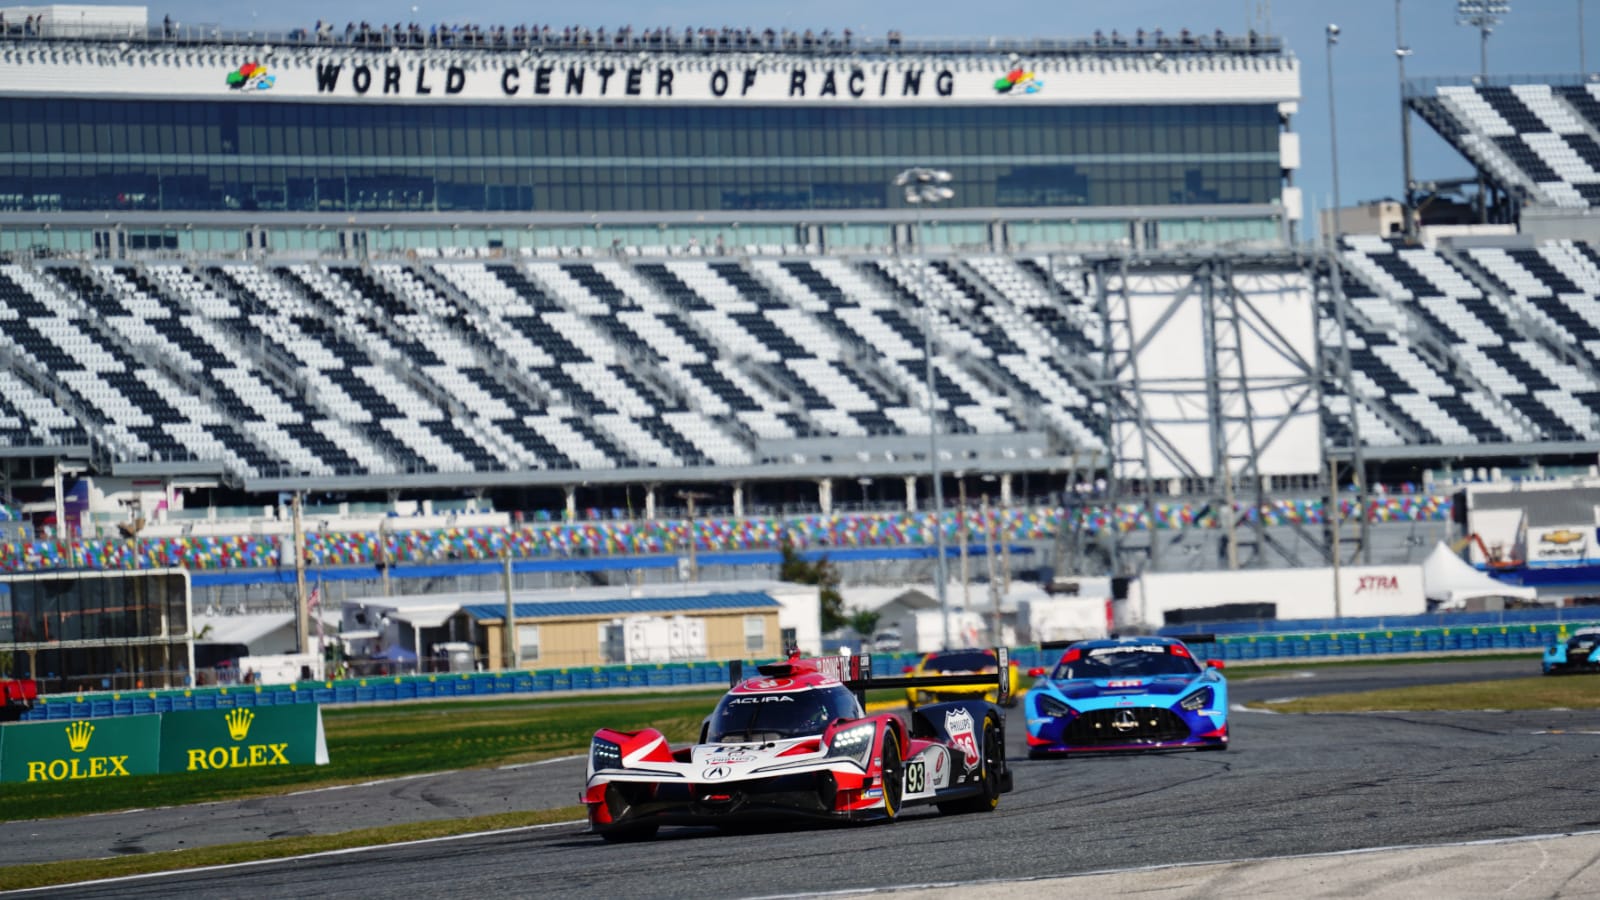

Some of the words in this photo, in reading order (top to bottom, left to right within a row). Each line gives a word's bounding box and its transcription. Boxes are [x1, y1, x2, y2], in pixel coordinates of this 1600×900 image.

[317, 65, 466, 94] WORLD
[502, 68, 674, 95] CENTER
[710, 69, 758, 95] OF
[789, 69, 954, 97] RACING
[1355, 576, 1399, 594] XTRA
[728, 696, 794, 705] ACURA
[949, 717, 971, 732] PHILLIPS
[27, 755, 130, 782] ROLEX
[187, 743, 290, 771] ROLEX
[908, 763, 924, 792] 93
